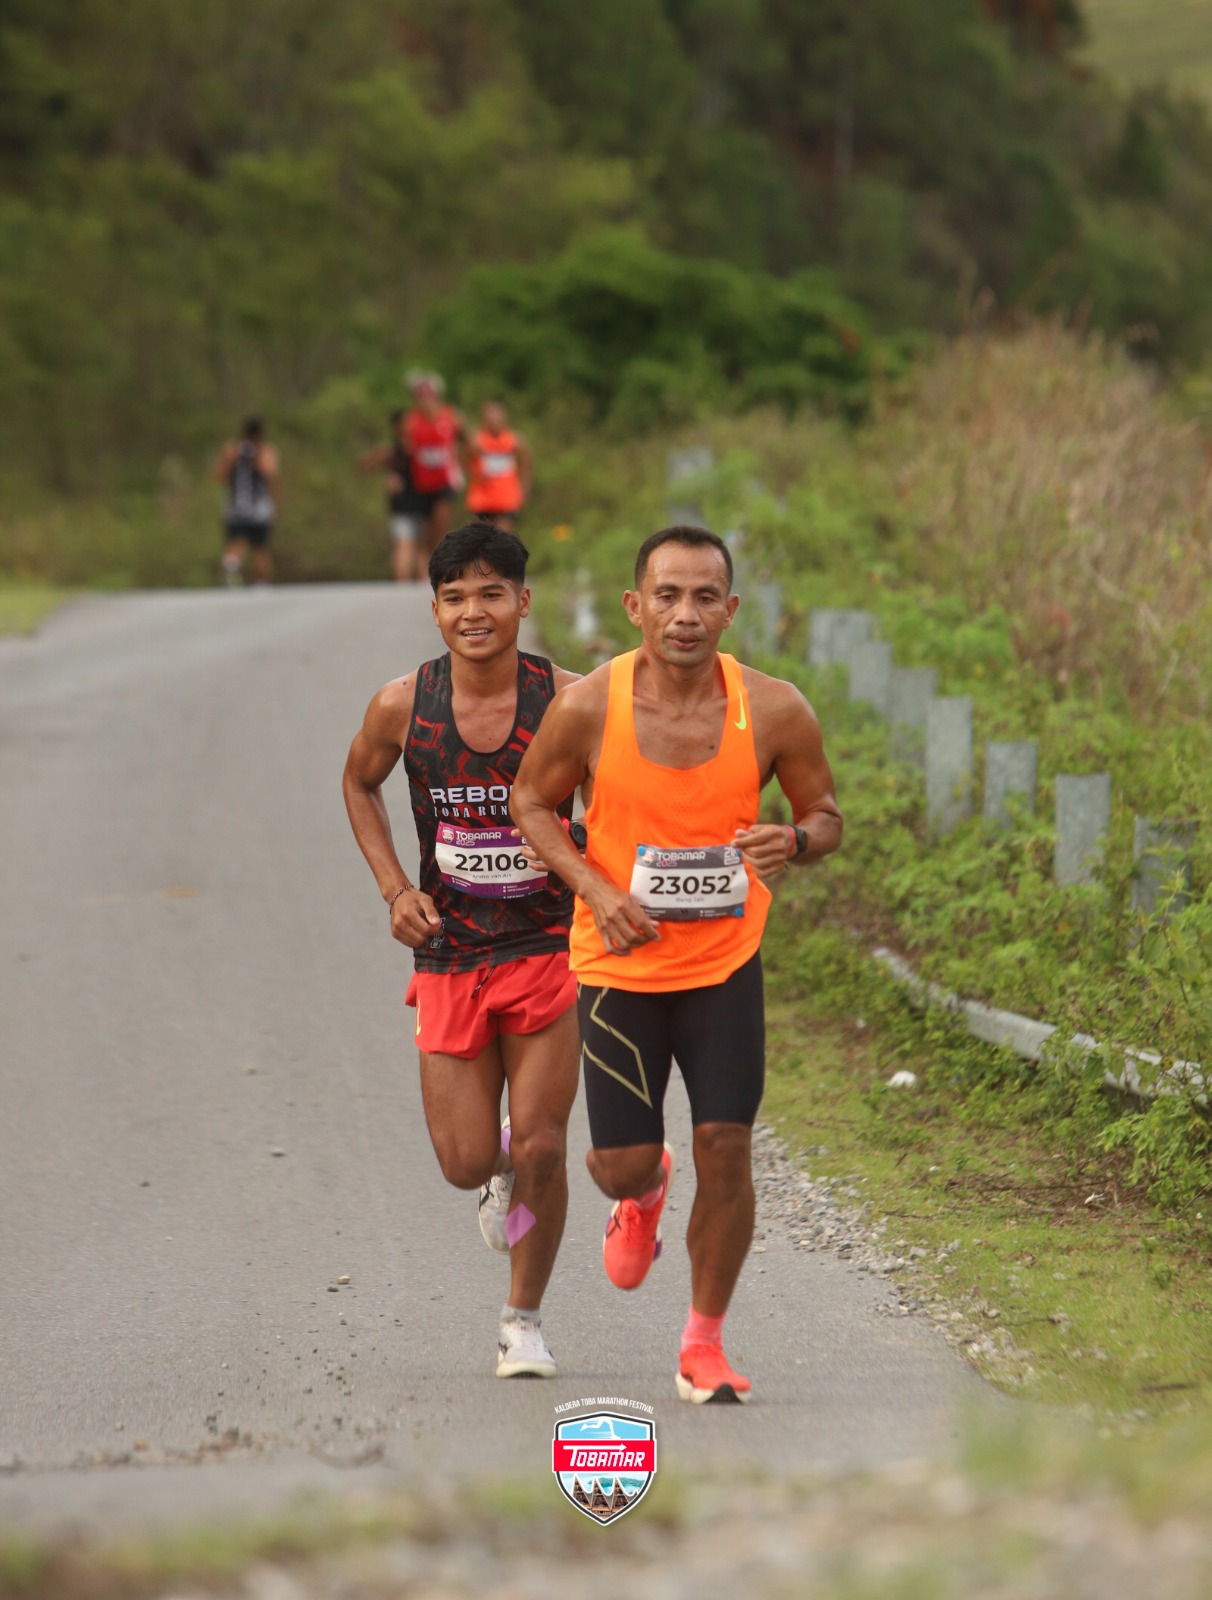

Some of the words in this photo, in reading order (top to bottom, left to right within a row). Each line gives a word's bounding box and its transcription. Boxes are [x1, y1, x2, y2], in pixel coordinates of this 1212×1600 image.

[429, 785, 513, 804] REBO
[455, 831, 502, 840] TOBAMAR
[454, 853, 528, 872] 22106
[656, 851, 706, 861] TOBAMAR
[656, 860, 678, 868] 2025
[649, 875, 732, 895] 23052
